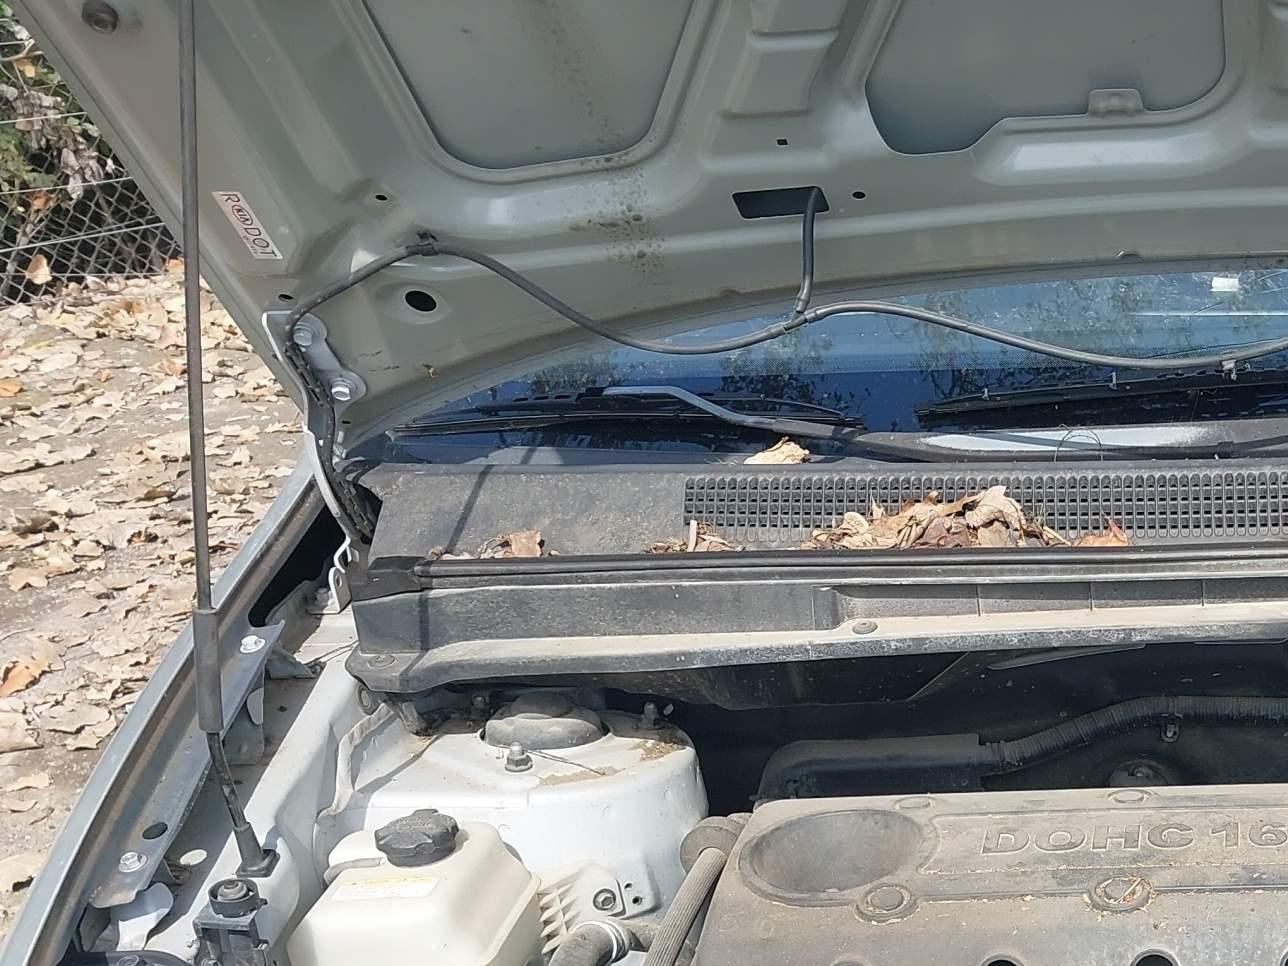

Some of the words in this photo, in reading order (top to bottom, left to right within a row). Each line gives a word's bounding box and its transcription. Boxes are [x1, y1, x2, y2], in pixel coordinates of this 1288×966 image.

[220, 193, 240, 203] R
[244, 227, 278, 258] DOT
[980, 821, 1194, 855] DOHC
